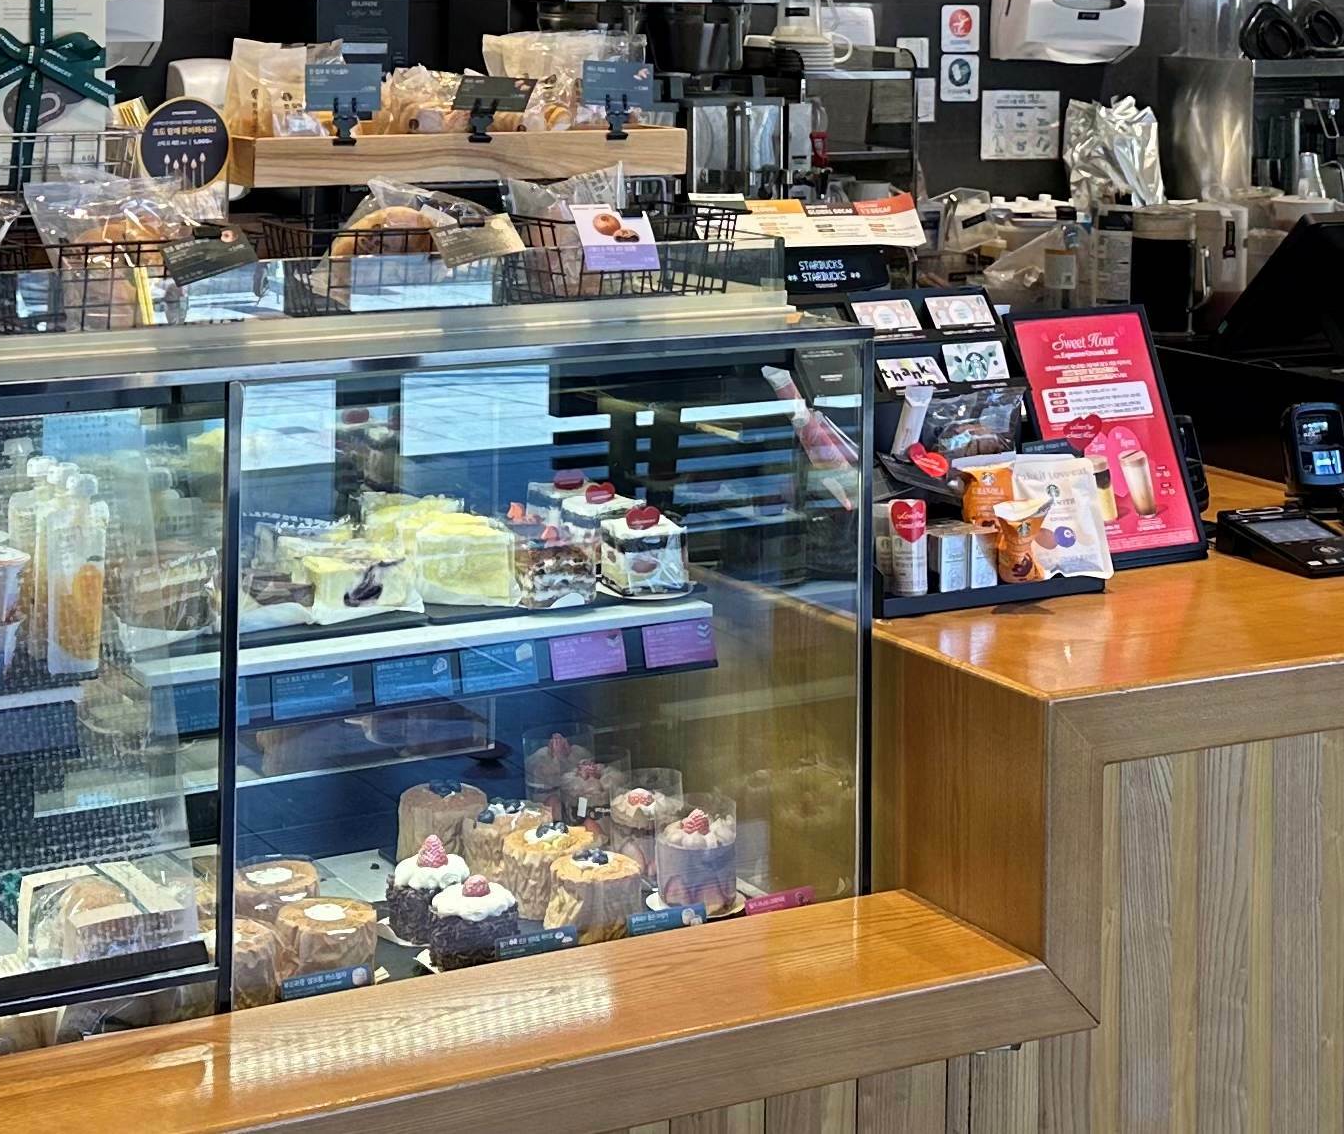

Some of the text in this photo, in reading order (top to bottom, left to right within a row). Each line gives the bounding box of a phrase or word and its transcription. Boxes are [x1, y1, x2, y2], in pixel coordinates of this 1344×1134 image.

[798, 259, 844, 271] STARBUCKS
[801, 271, 847, 282] STARBUCKS
[1051, 332, 1118, 351] Sweet Hour
[881, 364, 930, 382] thank
